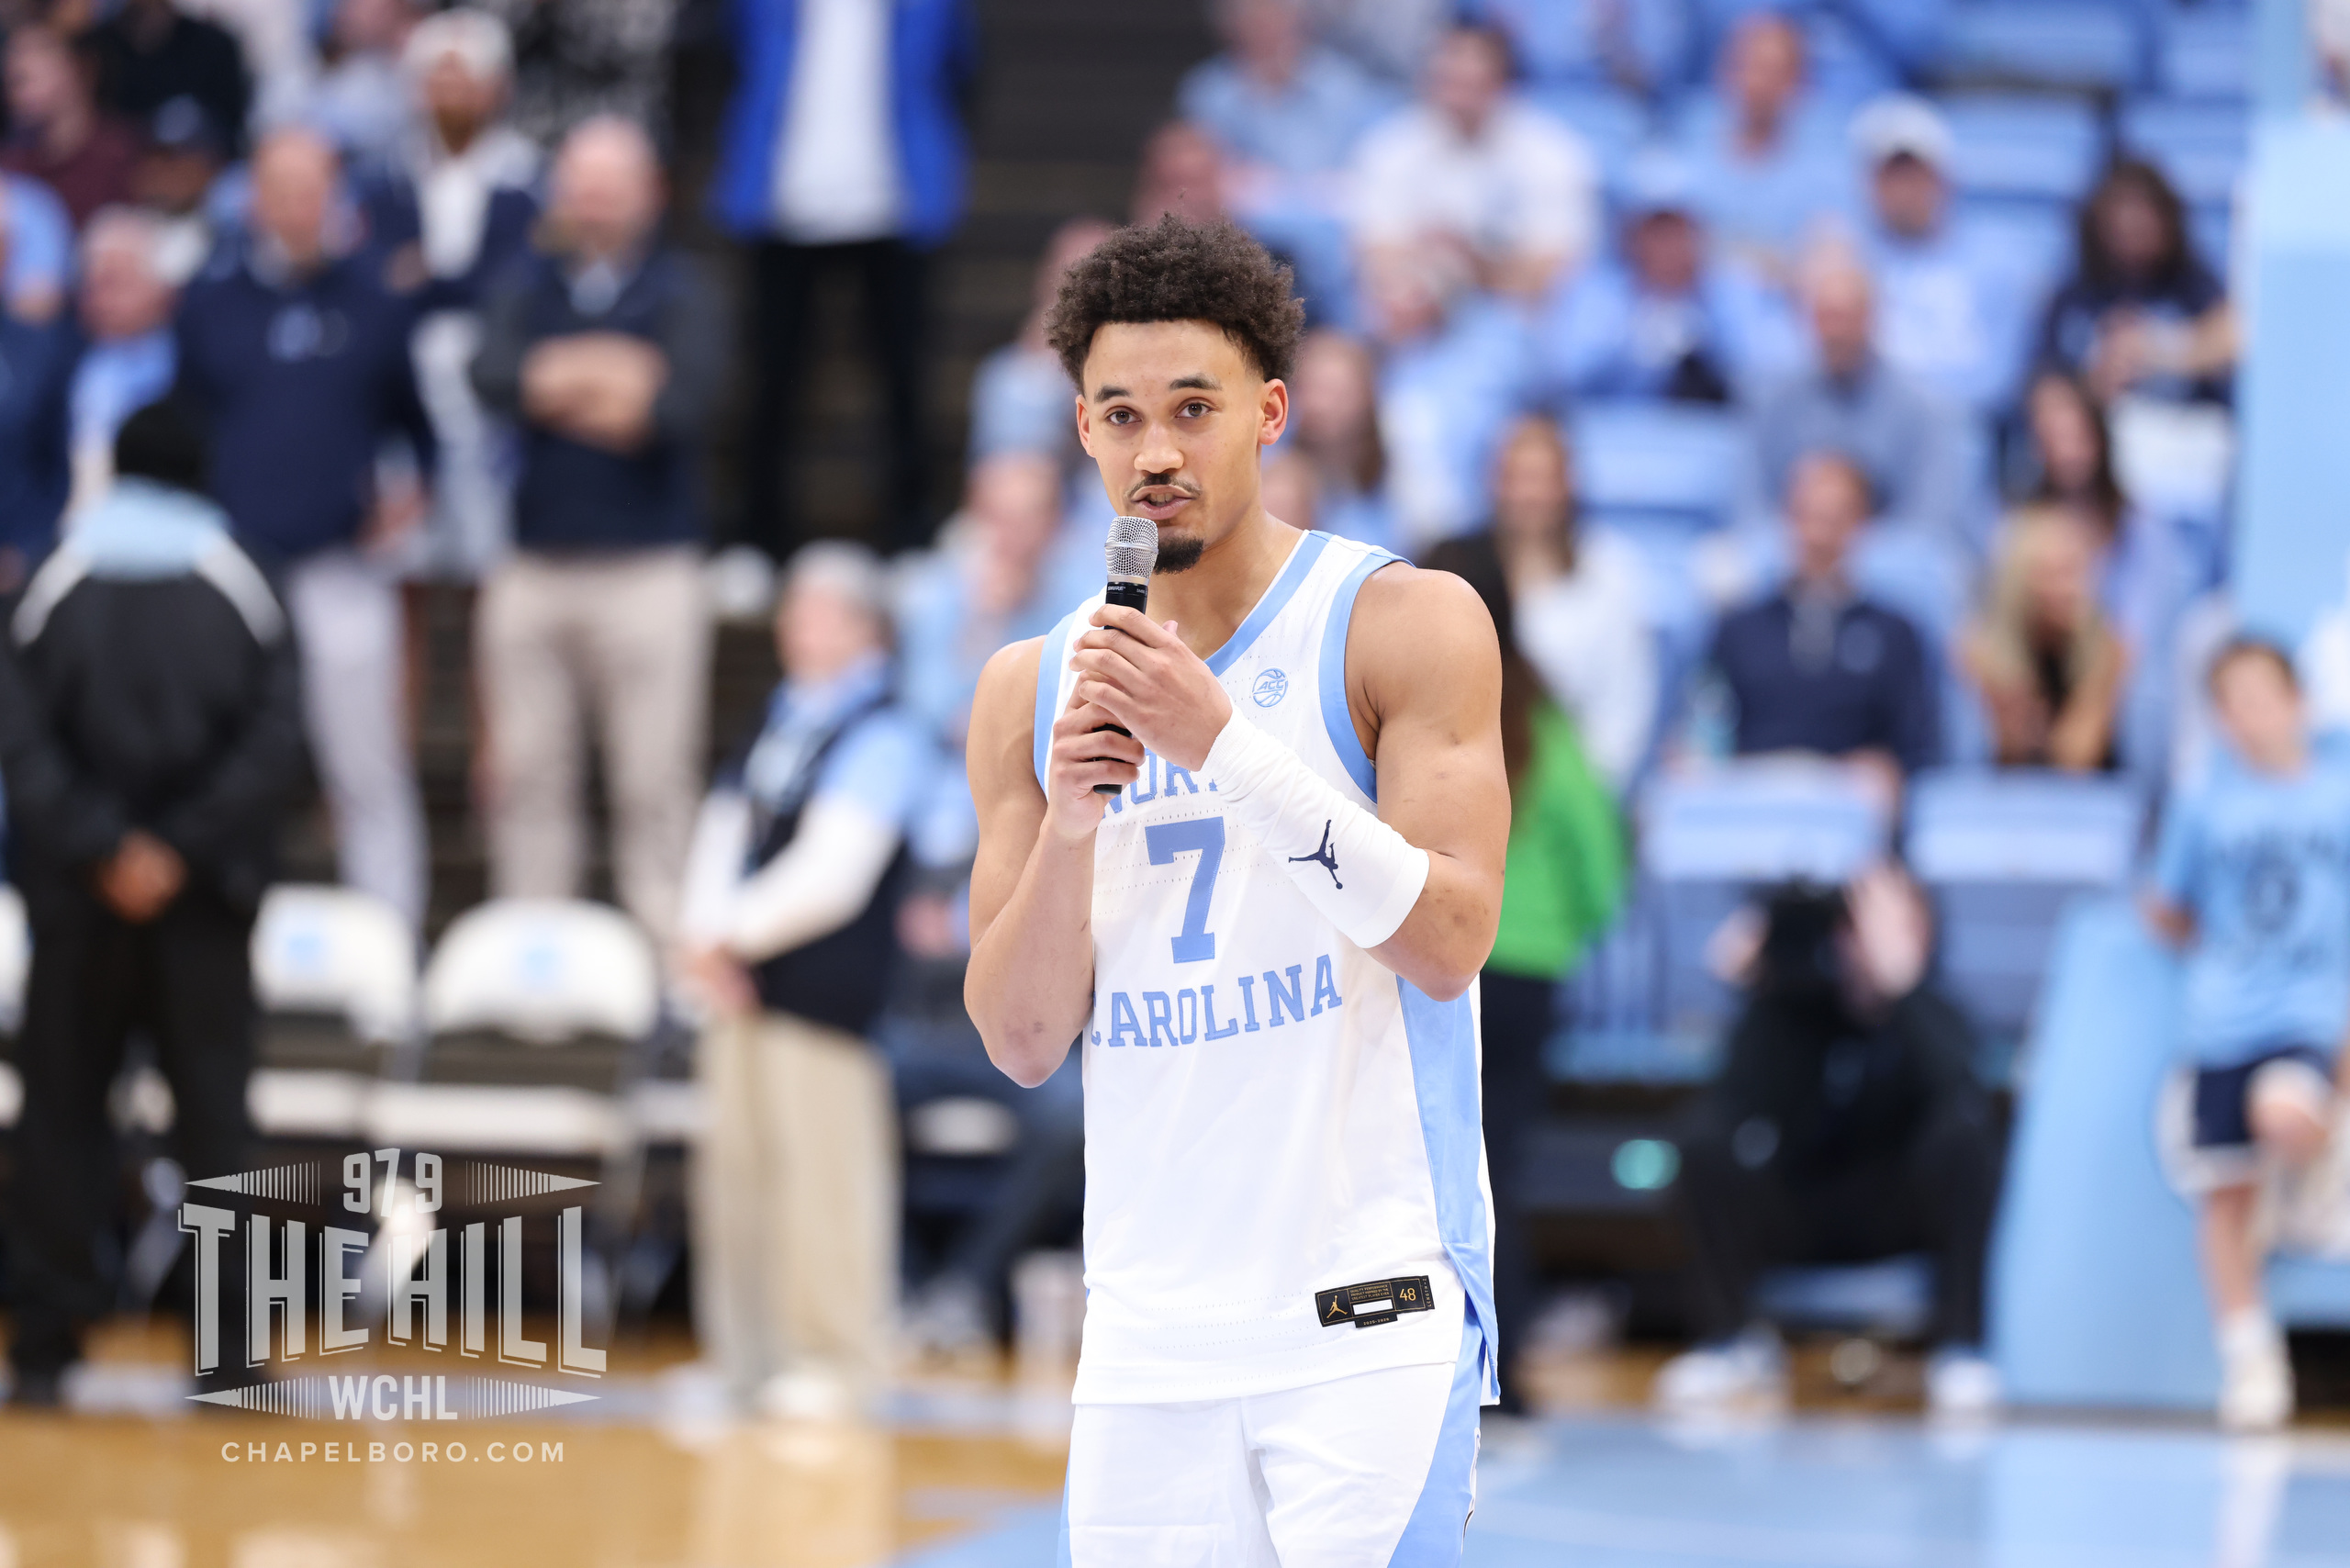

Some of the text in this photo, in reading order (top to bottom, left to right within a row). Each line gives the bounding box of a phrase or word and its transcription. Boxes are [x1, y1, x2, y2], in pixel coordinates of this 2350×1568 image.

[1257, 679, 1285, 691] ACC
[1145, 816, 1225, 963] 7
[1091, 954, 1343, 1047] AROLINA
[1399, 1287, 1416, 1301] 48
